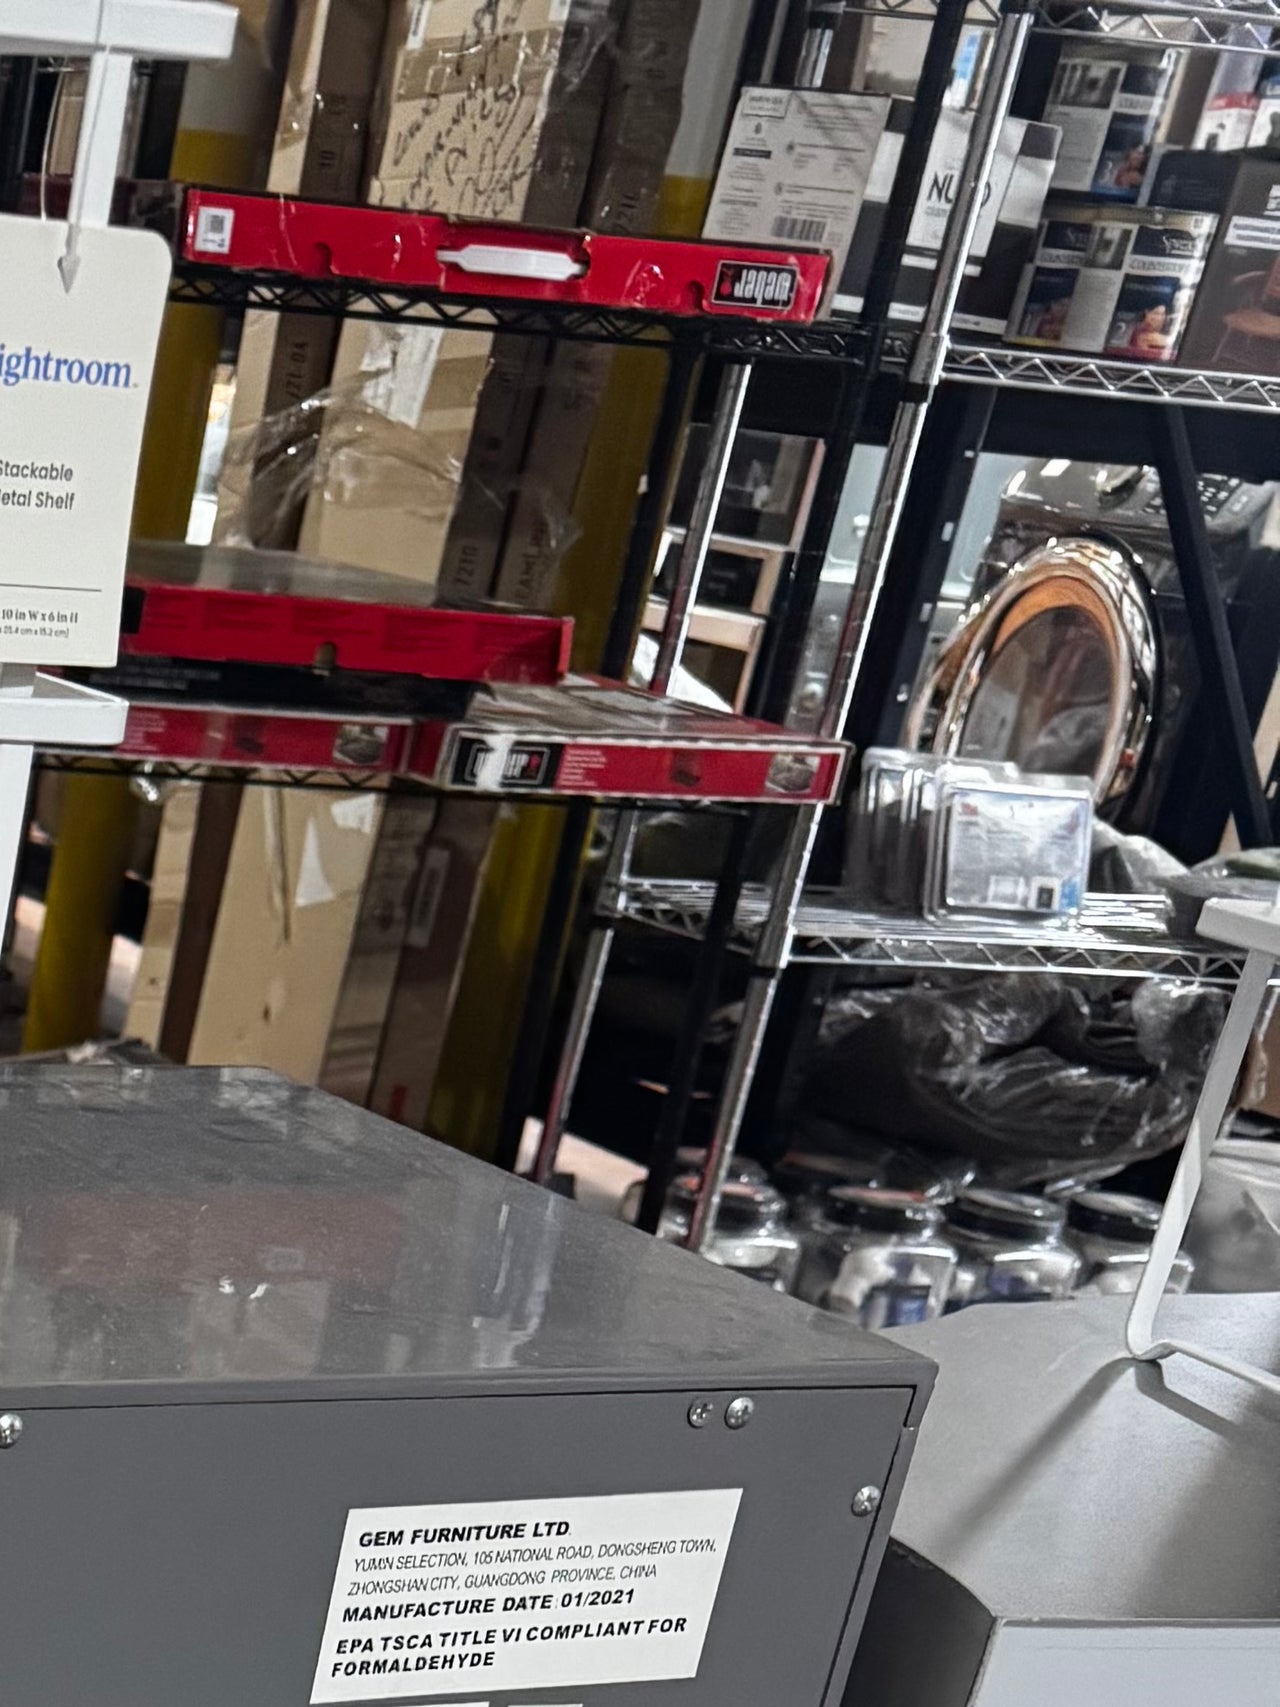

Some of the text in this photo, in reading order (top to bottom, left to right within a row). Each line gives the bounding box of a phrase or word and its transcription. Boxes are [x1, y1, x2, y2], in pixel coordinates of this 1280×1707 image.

[35, 491, 75, 511] Shelf
[359, 1530, 404, 1547] GEM
[411, 1523, 527, 1545] FURNITURE
[396, 1552, 468, 1570] SELECTION,
[474, 1550, 493, 1565] 105
[494, 1547, 554, 1564] NATIONAL
[557, 1544, 595, 1561] ROAD,
[598, 1540, 676, 1559] DONGSHENG
[347, 1577, 429, 1597] ZHONGSHAN
[430, 1575, 461, 1591] CITY,
[464, 1570, 546, 1590] GUANGDONG
[620, 1563, 658, 1579] CHINA
[342, 1598, 496, 1623] MANUFACTURE
[336, 1617, 688, 1655] EPA TSCA TITLE VI COMPLIANT FOR
[331, 1651, 496, 1678] FORMALDEHYDE
